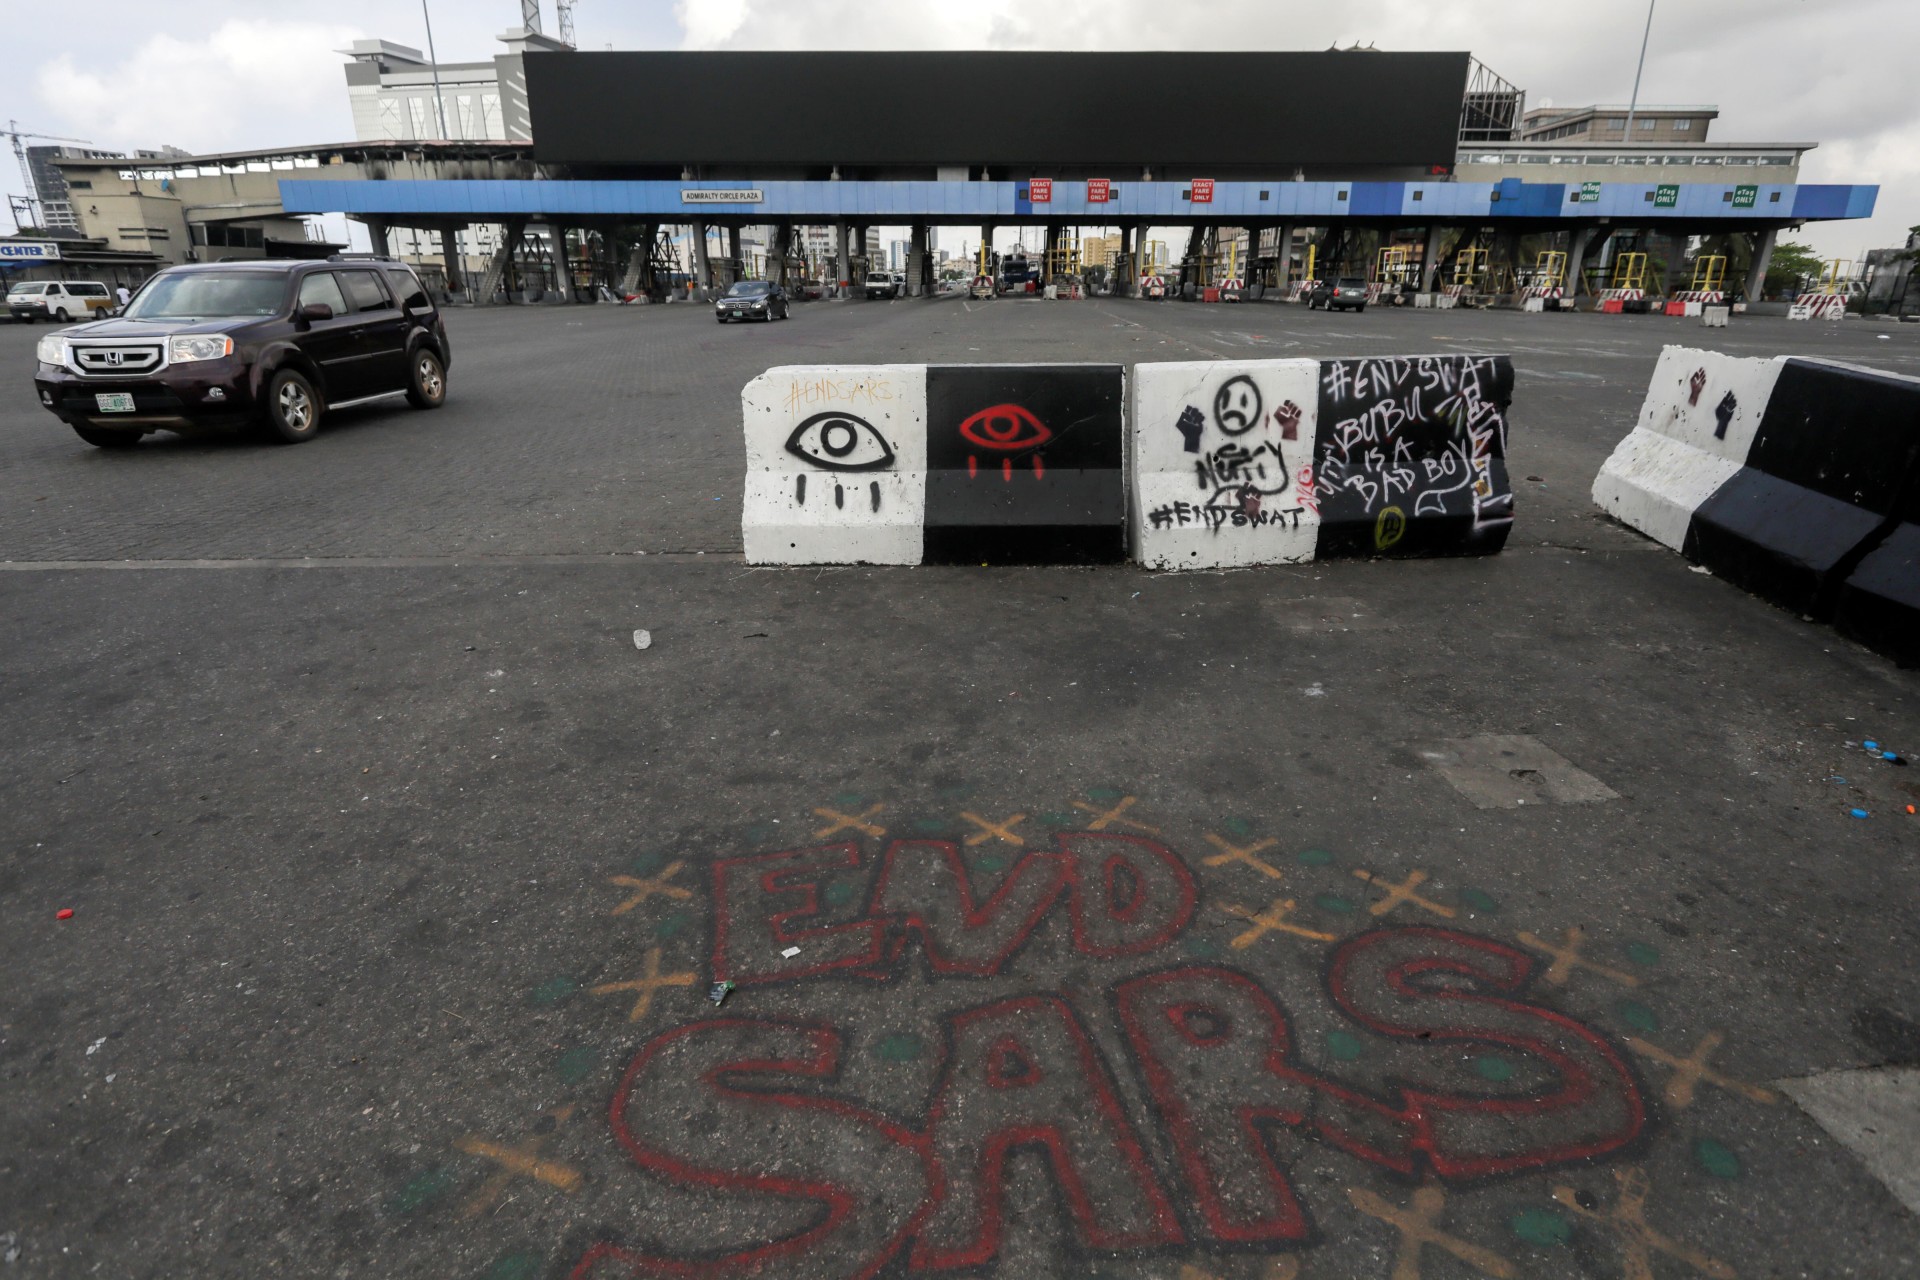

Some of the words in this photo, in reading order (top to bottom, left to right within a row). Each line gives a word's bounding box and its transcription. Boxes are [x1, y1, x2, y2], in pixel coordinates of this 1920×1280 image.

[1582, 183, 1600, 193] eTag
[1736, 189, 1754, 197] eTag
[686, 192, 718, 200] ADMIRALTY
[719, 192, 739, 200] CIRCLE
[740, 192, 758, 200] PLAZA
[1581, 193, 1599, 201] ONLY
[1735, 196, 1753, 204] ONLY
[0, 246, 44, 256] CENTER
[1335, 385, 1430, 450] BUBU
[1364, 446, 1386, 473] IS
[1392, 436, 1415, 469] A
[1343, 468, 1416, 513] BAD
[1418, 438, 1473, 490] BOY
[708, 832, 1200, 984] END
[566, 924, 1652, 1280] SARS
